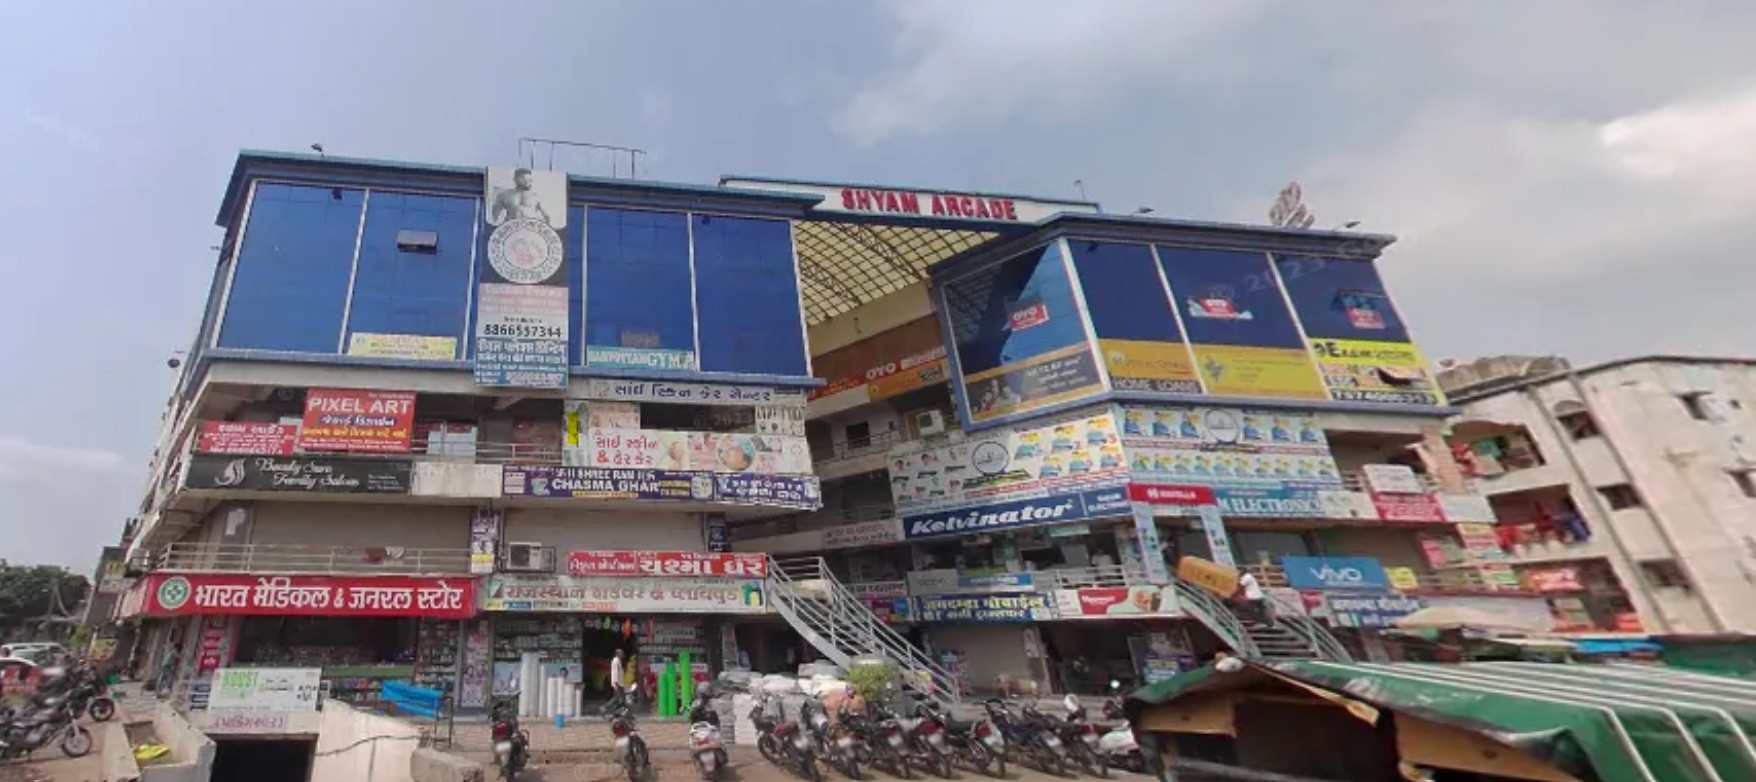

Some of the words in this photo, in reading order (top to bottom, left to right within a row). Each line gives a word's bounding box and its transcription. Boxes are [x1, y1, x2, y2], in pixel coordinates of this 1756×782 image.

[841, 187, 920, 214] SHYAM
[931, 194, 1017, 221] ARCADE
[866, 363, 897, 379] OYO
[307, 397, 365, 413] PIXEL
[369, 400, 411, 414] ART
[552, 478, 614, 491] CHASMA
[618, 479, 659, 492] GHAR
[911, 503, 1071, 535] Kelvinator
[195, 585, 250, 607] भारत
[253, 577, 331, 608] मेडिकल
[348, 586, 414, 609] जनरल
[417, 580, 464, 609] स्टोर
